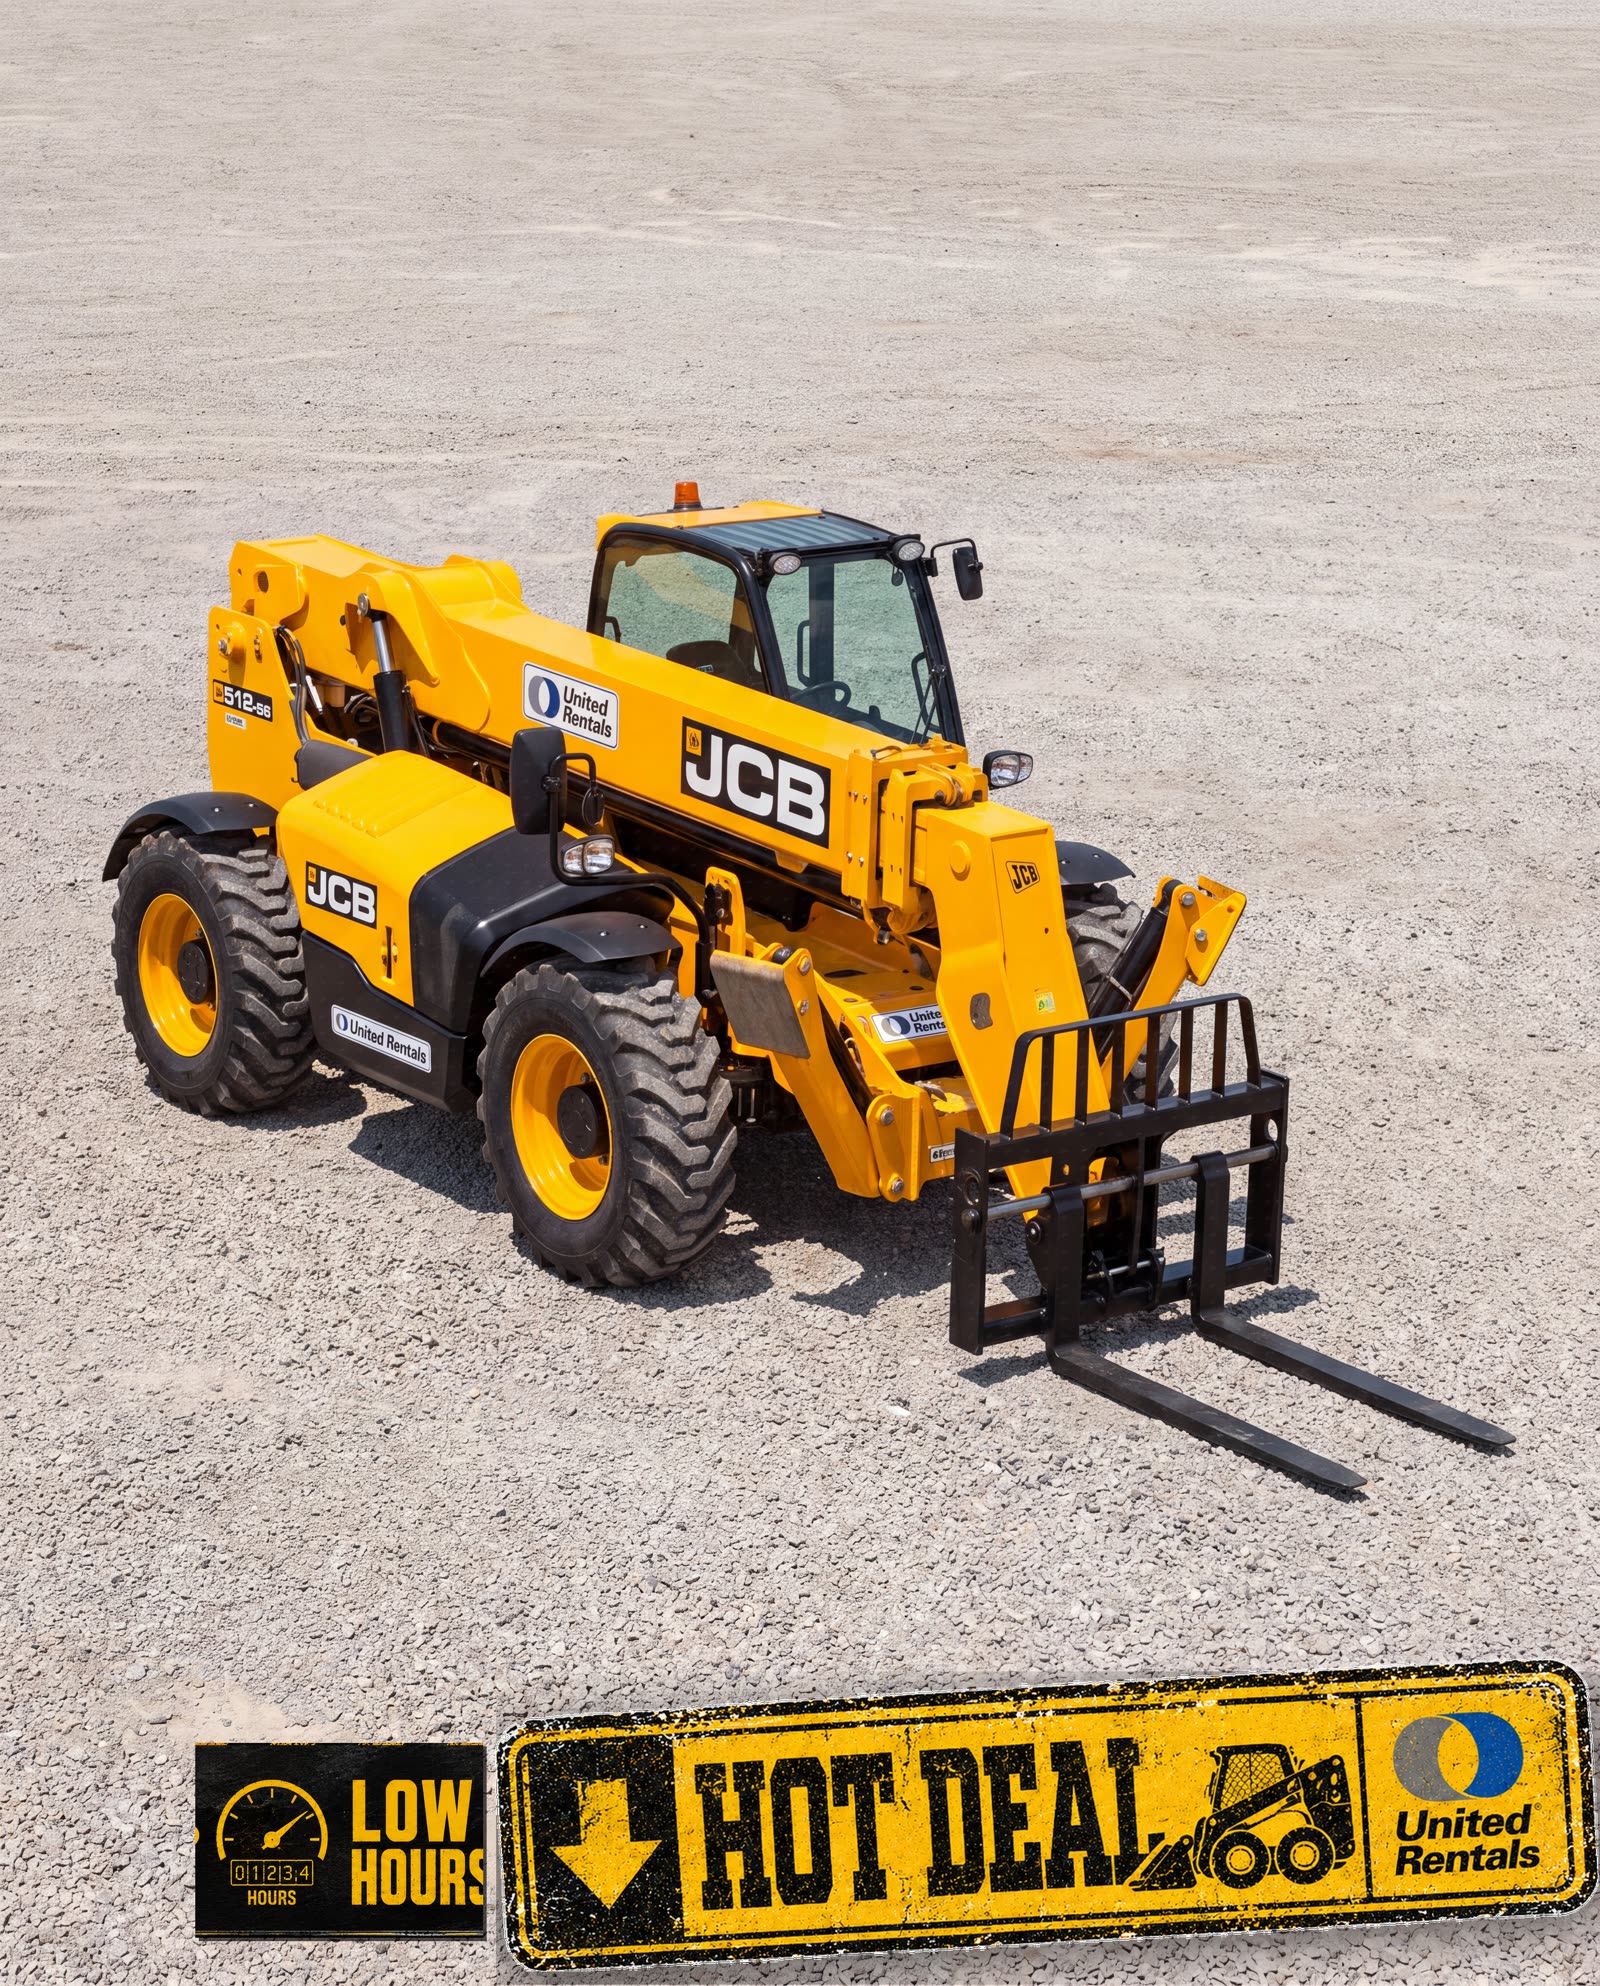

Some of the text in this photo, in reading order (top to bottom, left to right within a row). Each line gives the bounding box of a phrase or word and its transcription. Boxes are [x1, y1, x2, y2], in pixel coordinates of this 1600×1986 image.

[224, 685, 271, 719] 512-56
[563, 685, 609, 717] United
[562, 705, 612, 738] Rentals
[685, 734, 826, 836] JCB
[1011, 864, 1038, 890] JCB
[307, 870, 376, 924] JCB
[350, 1018, 427, 1065] United Rentals
